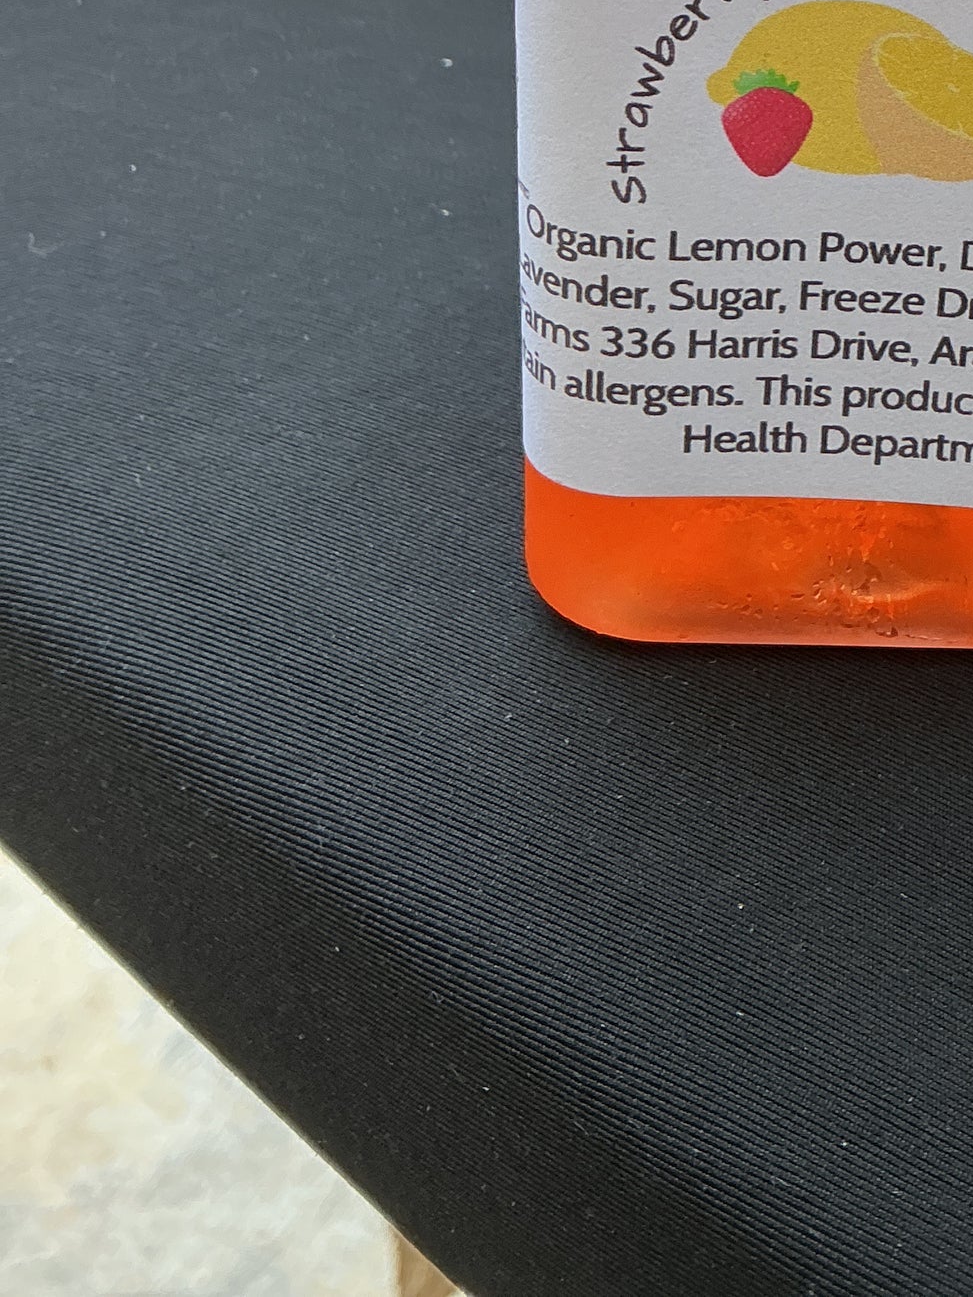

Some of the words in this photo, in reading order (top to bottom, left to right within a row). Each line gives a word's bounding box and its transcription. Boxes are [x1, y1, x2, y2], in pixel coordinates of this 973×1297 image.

[527, 204, 657, 262] Organic
[669, 231, 806, 262] Lemon
[820, 232, 946, 272] Power,
[520, 253, 656, 314] avender,
[669, 280, 786, 321] Sugar,
[800, 281, 926, 315] Freeze
[600, 326, 675, 359] 336
[688, 329, 799, 359] Harris
[811, 330, 918, 367] Drive,
[564, 369, 743, 416] allergens.
[756, 374, 832, 408] This
[684, 421, 807, 454] Health
